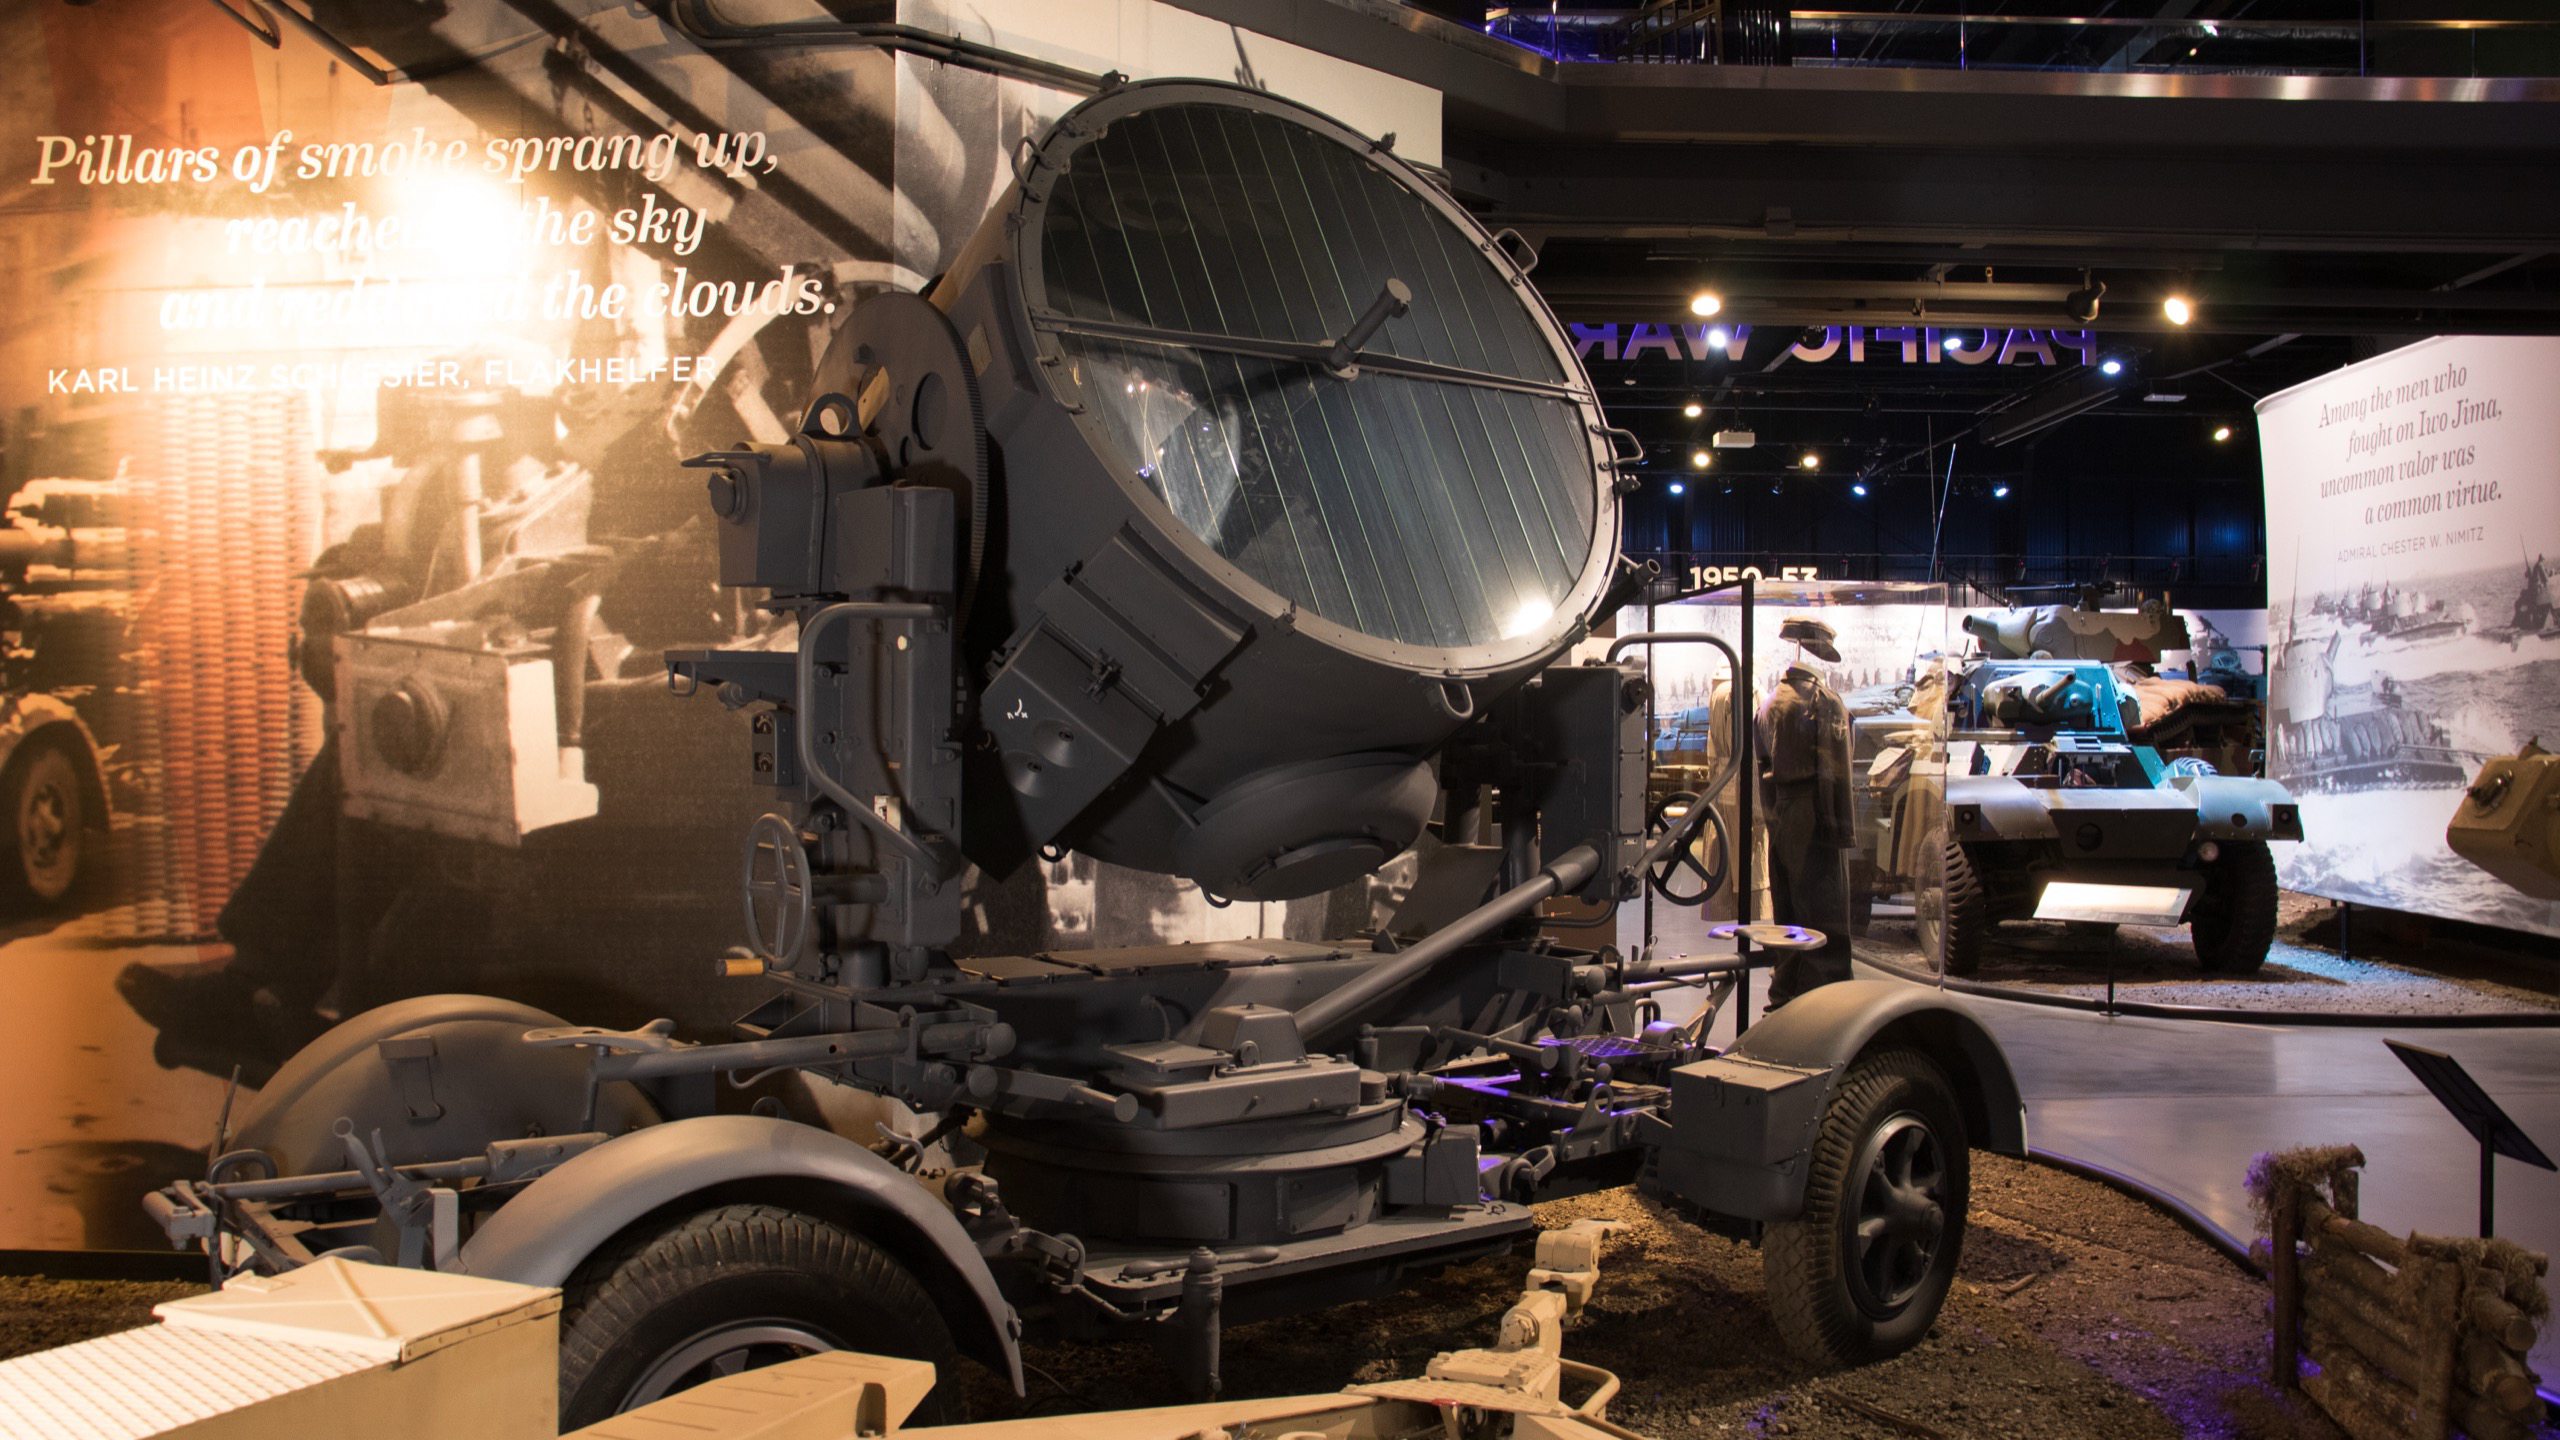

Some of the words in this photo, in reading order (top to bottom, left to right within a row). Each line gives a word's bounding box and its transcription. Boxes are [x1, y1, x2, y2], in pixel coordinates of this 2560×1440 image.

[30, 134, 219, 185] Pillars
[232, 129, 293, 193] of
[297, 128, 468, 180] smoke
[483, 131, 680, 184] sprang
[692, 128, 779, 178] up,
[224, 199, 440, 255] reache
[516, 196, 596, 247] the
[609, 193, 708, 256] sky
[159, 275, 267, 330] and
[543, 269, 625, 321] the
[643, 264, 837, 319] clouds.
[47, 366, 139, 394] KARL
[153, 363, 257, 393] HEINZ
[484, 355, 717, 386] FLAKHELFER
[2317, 394, 2370, 429] Among
[2370, 384, 2393, 414] the
[2396, 377, 2430, 406] men
[2433, 363, 2467, 394] who
[2346, 422, 2394, 464] fought
[2396, 419, 2415, 444] on
[2418, 409, 2448, 439] Iwo
[2451, 396, 2503, 430] Jima,
[2320, 465, 2395, 500] uncommon
[2398, 450, 2439, 481] valor
[2442, 444, 2475, 472] was
[2364, 507, 2374, 526] a
[2377, 490, 2442, 524] common
[2446, 479, 2503, 509] virtue.
[2336, 545, 2378, 564] ADMIRAL
[2380, 537, 2427, 557] CHESTER
[2429, 535, 2443, 550] W.
[2446, 526, 2485, 546] NIMITZ
